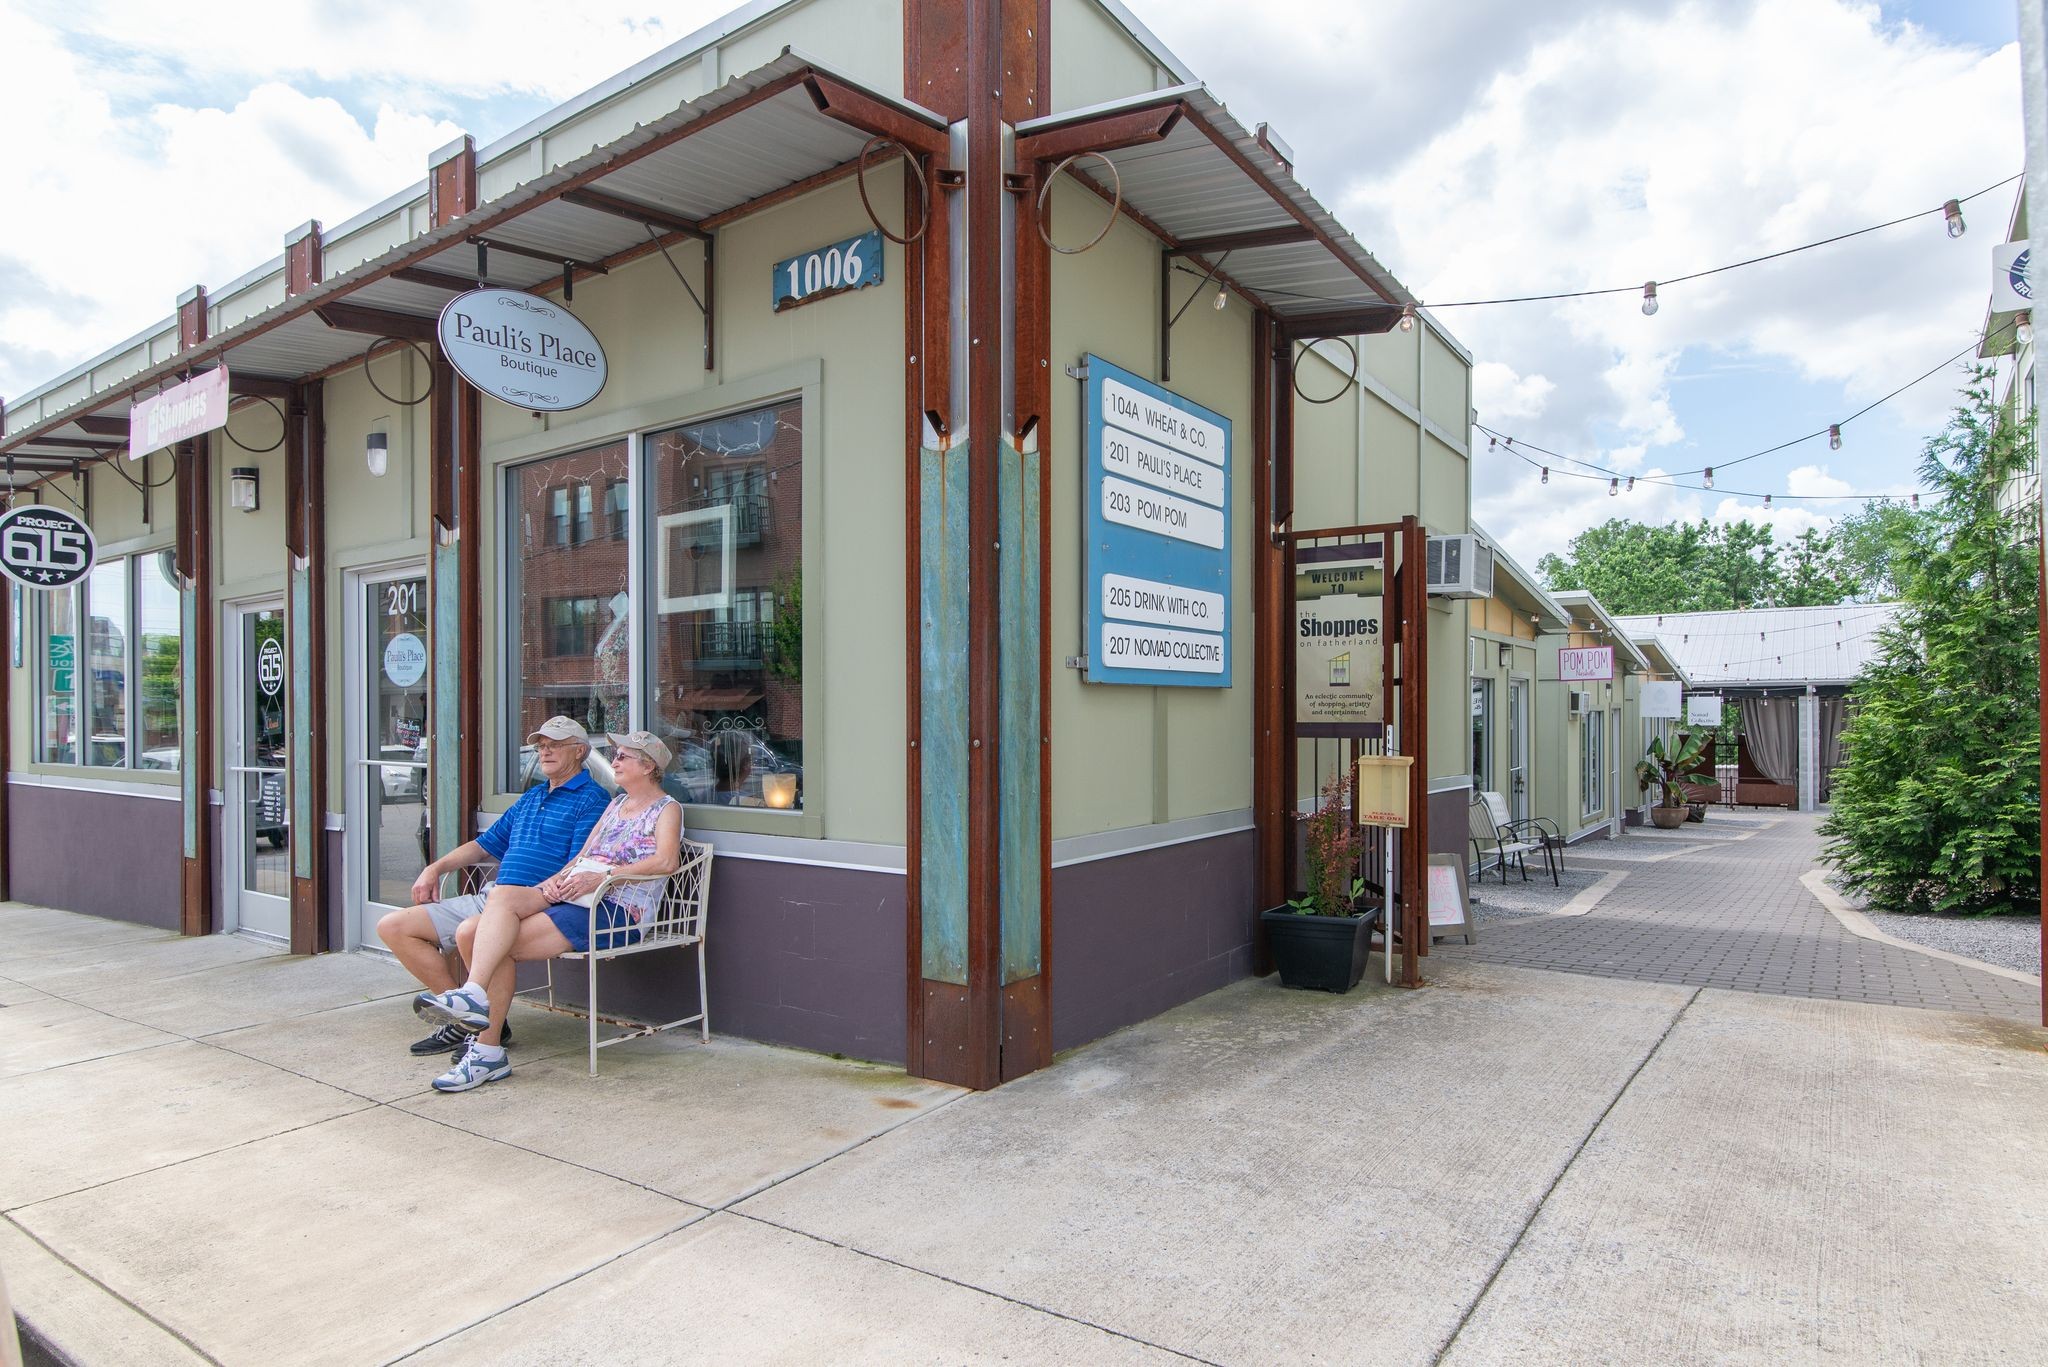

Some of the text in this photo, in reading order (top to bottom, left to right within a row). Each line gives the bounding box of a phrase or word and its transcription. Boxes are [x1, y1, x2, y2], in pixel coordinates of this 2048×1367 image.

[787, 239, 863, 300] 1006
[454, 312, 596, 368] Pauli's Place
[500, 355, 558, 378] Boutique
[159, 391, 208, 434] Shoppes
[1111, 393, 1207, 449] 104A WHEAT & CO.
[1109, 441, 1202, 489] 201 PAULI'S PLACE
[1109, 491, 1187, 528] 203 POM POM
[17, 516, 75, 531] PROJECT
[3, 526, 86, 571] 615
[1311, 571, 1364, 583] WELCOME
[1331, 583, 1344, 593] TO
[388, 582, 417, 615] 201
[1110, 587, 1209, 619] 205 DRINK WITH CO.
[1300, 618, 1378, 638] Shoppes
[1110, 636, 1219, 661] 207 NOMAD COLLECTIVE
[1317, 637, 1378, 647] fatherland
[261, 654, 281, 681] 615
[407, 649, 424, 662] Place
[1563, 650, 1608, 670] POM POM
[1338, 693, 1373, 701] community
